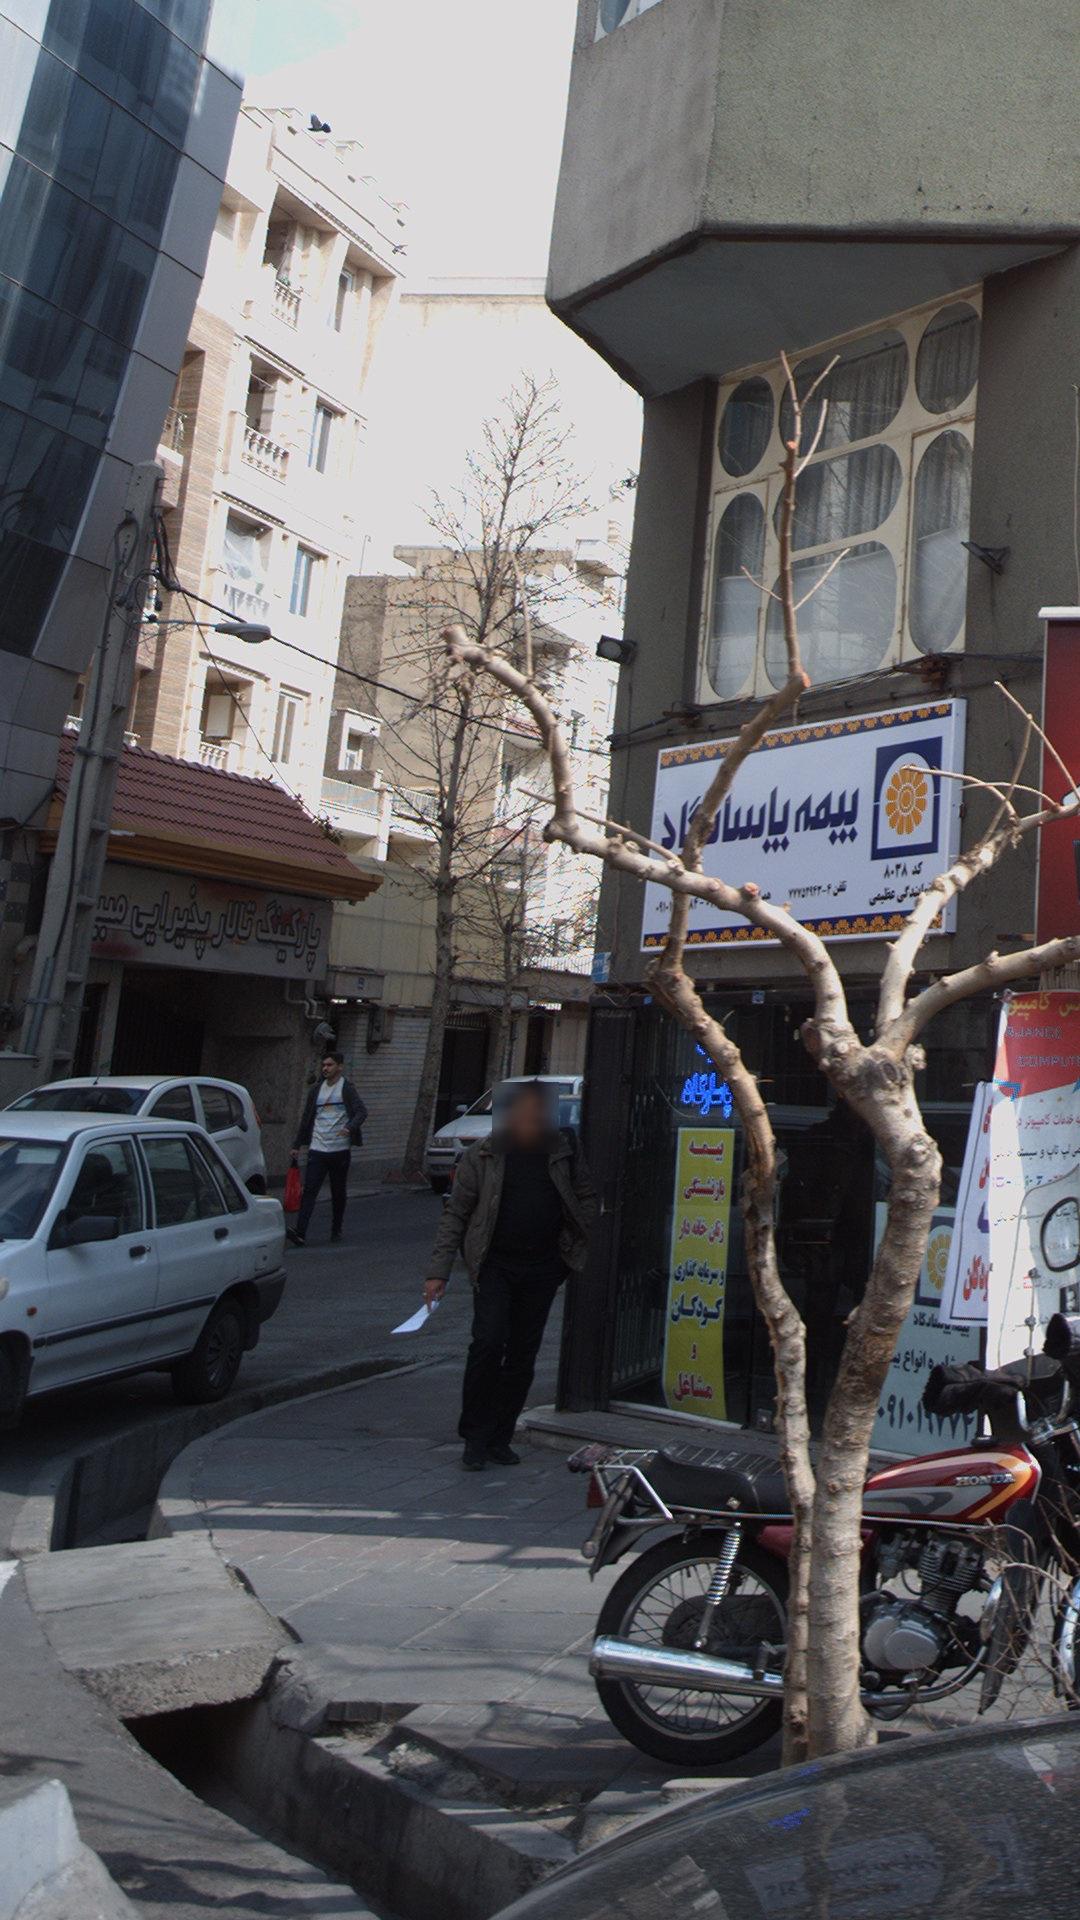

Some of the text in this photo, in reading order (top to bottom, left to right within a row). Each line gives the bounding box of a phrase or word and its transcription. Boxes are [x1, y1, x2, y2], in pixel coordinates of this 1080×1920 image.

[795, 787, 860, 846] بیمه
[912, 861, 923, 875] کد
[833, 880, 848, 896] تلفن
[130, 883, 211, 960] پذیرایی
[211, 900, 257, 948] تالار
[257, 898, 322, 972] پارکینگ
[689, 1140, 724, 1162] بیمه
[671, 1292, 724, 1327] کودکان
[902, 1349, 927, 1374] انواع
[674, 1371, 714, 1402] مشاغل
[955, 1472, 1016, 1487] HONDA
